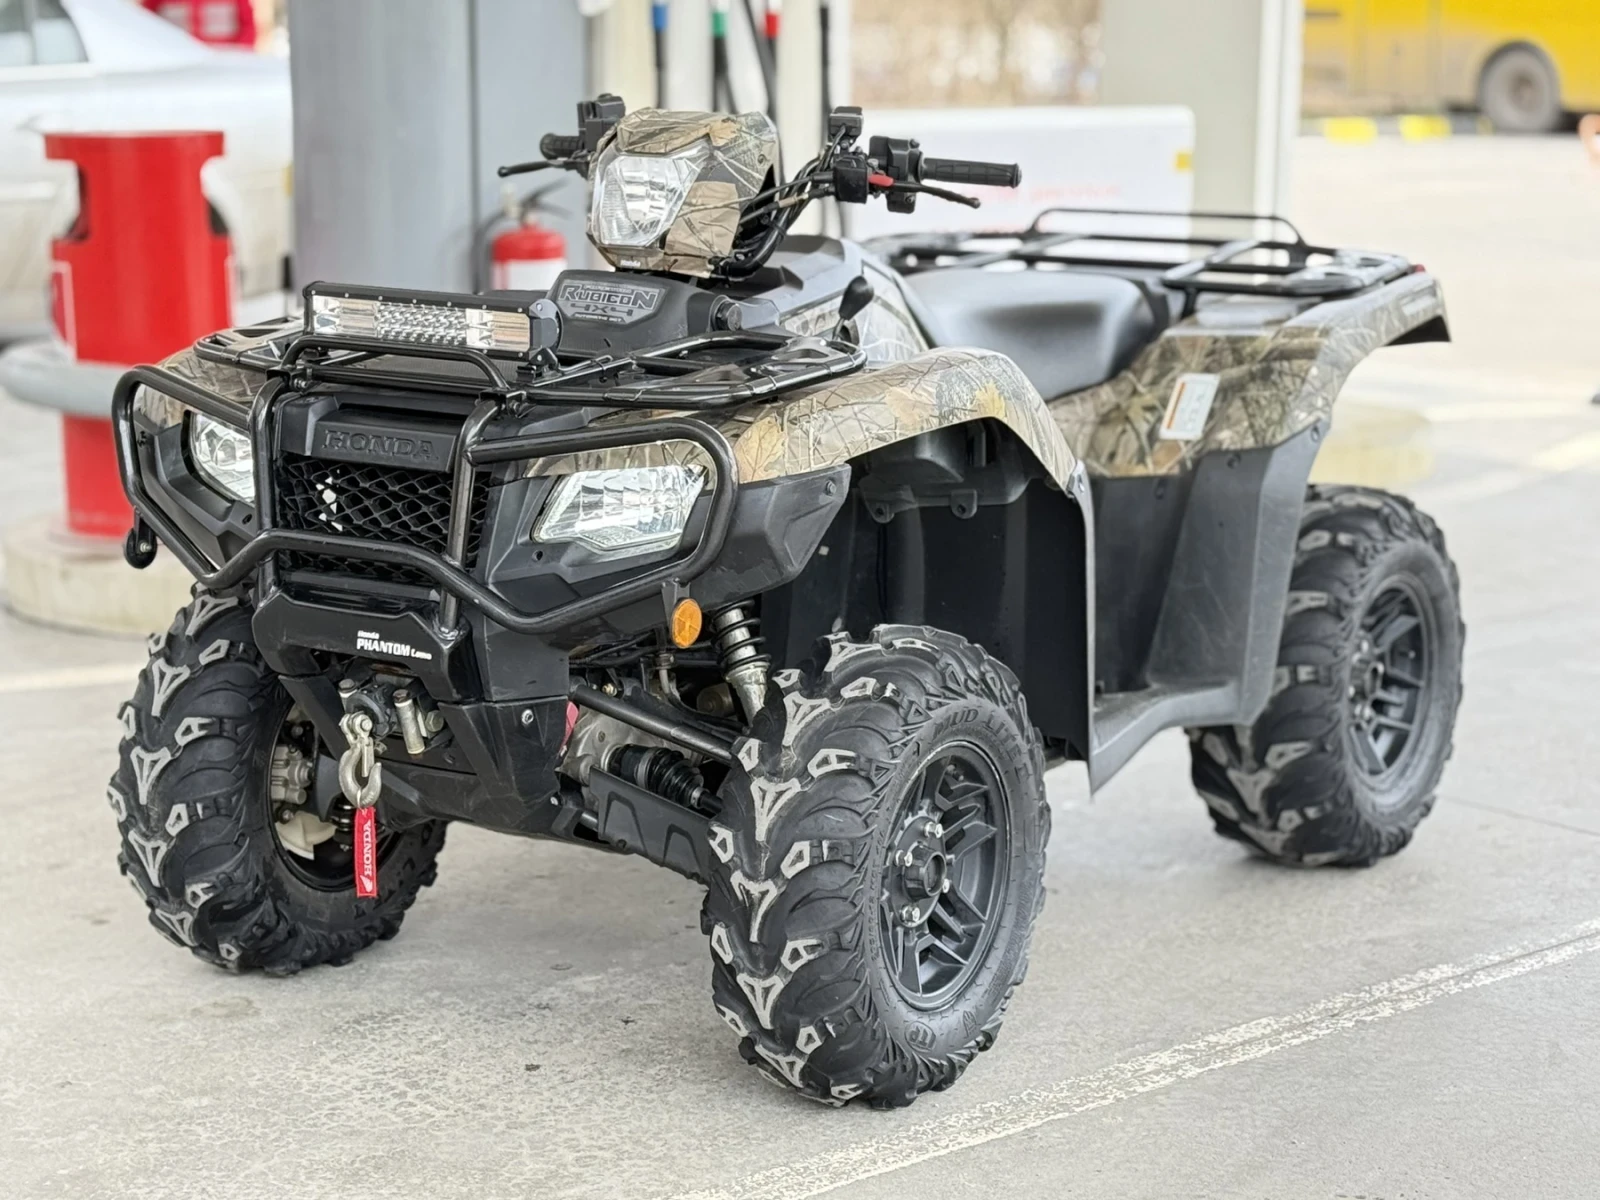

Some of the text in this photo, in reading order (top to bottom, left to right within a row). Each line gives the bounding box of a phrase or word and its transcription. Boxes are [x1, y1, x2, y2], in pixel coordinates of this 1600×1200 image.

[322, 429, 439, 461] HONDA
[356, 638, 411, 657] PHANTOM
[362, 819, 372, 877] HONDA
